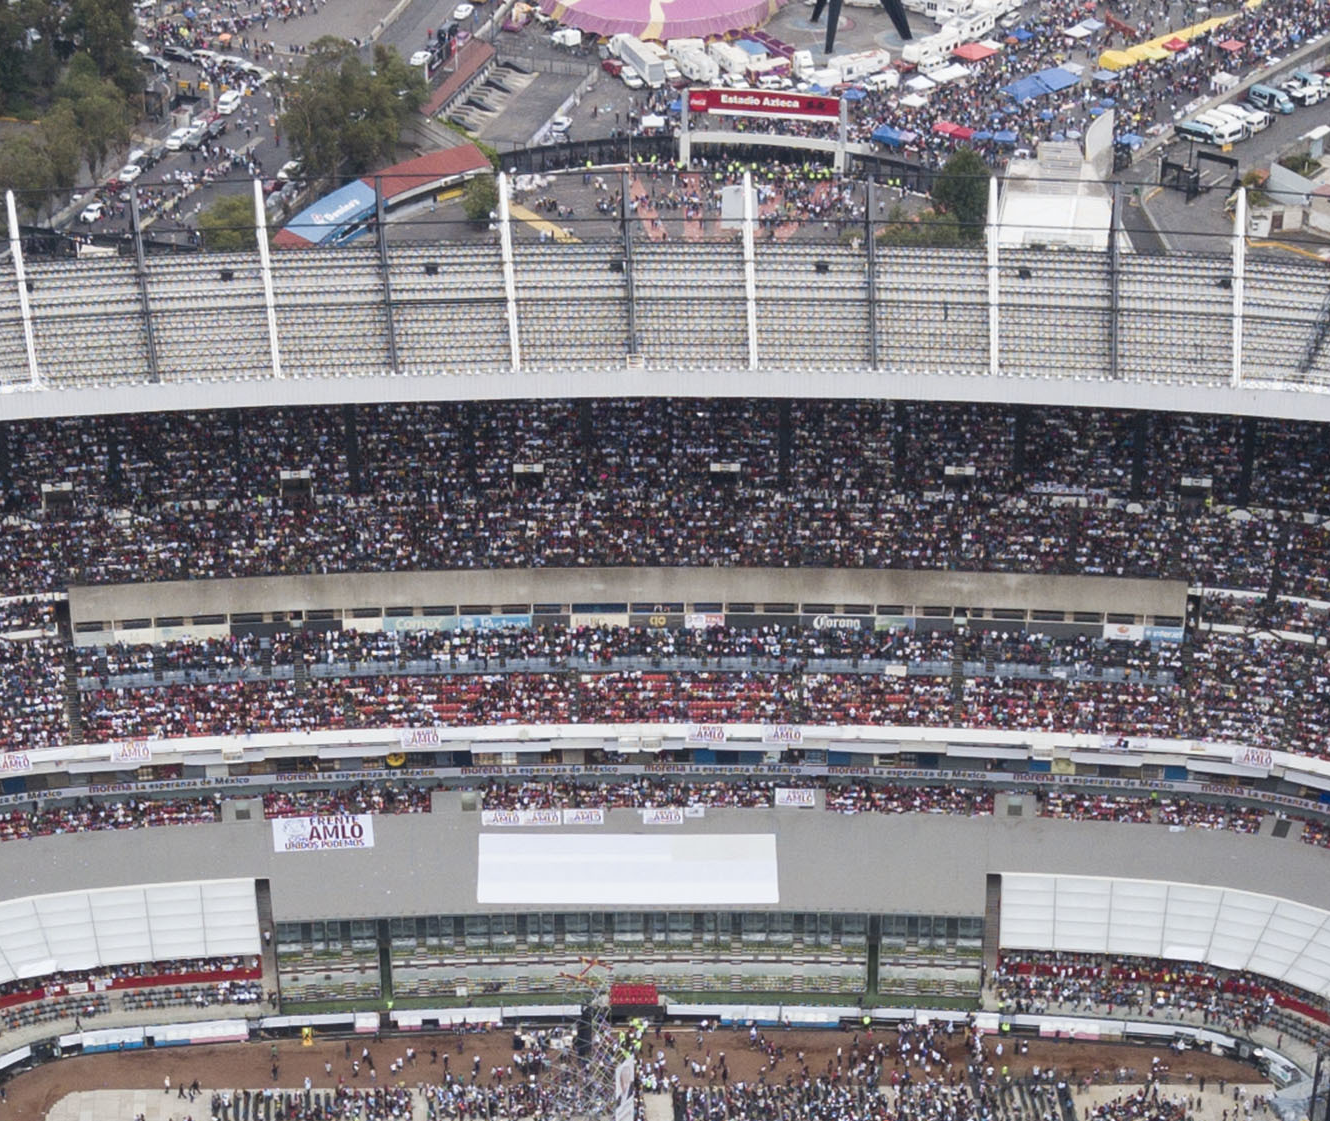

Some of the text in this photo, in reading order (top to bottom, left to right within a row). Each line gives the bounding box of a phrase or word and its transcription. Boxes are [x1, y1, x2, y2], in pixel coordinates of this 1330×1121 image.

[721, 94, 760, 106] Estadio
[762, 97, 800, 109] Azteca
[276, 771, 318, 782] morena
[335, 770, 383, 780] esperanza
[386, 769, 397, 777] de
[400, 766, 435, 777] México
[461, 766, 503, 776] morena
[520, 767, 568, 776] esperanza
[584, 764, 619, 774] México
[644, 764, 686, 773] morena
[702, 766, 750, 774] esperanza
[752, 765, 765, 773] de
[767, 764, 802, 774] México
[827, 766, 987, 780] morena La esperanza de México
[89, 776, 250, 794] morena La esperanza de México
[1013, 772, 1055, 782] morena
[1071, 776, 1122, 786] esperanza
[1124, 779, 1136, 787] de
[1139, 780, 1174, 790] México
[12, 794, 25, 803] de
[27, 790, 62, 801] México
[1201, 784, 1245, 796] morena
[1248, 788, 1259, 798] La
[1261, 792, 1310, 807] esperanza
[1311, 800, 1325, 809] de
[309, 816, 359, 826] FRENTE
[309, 824, 364, 842] AMLO
[285, 839, 365, 851] UNIDOS PODEMOS
